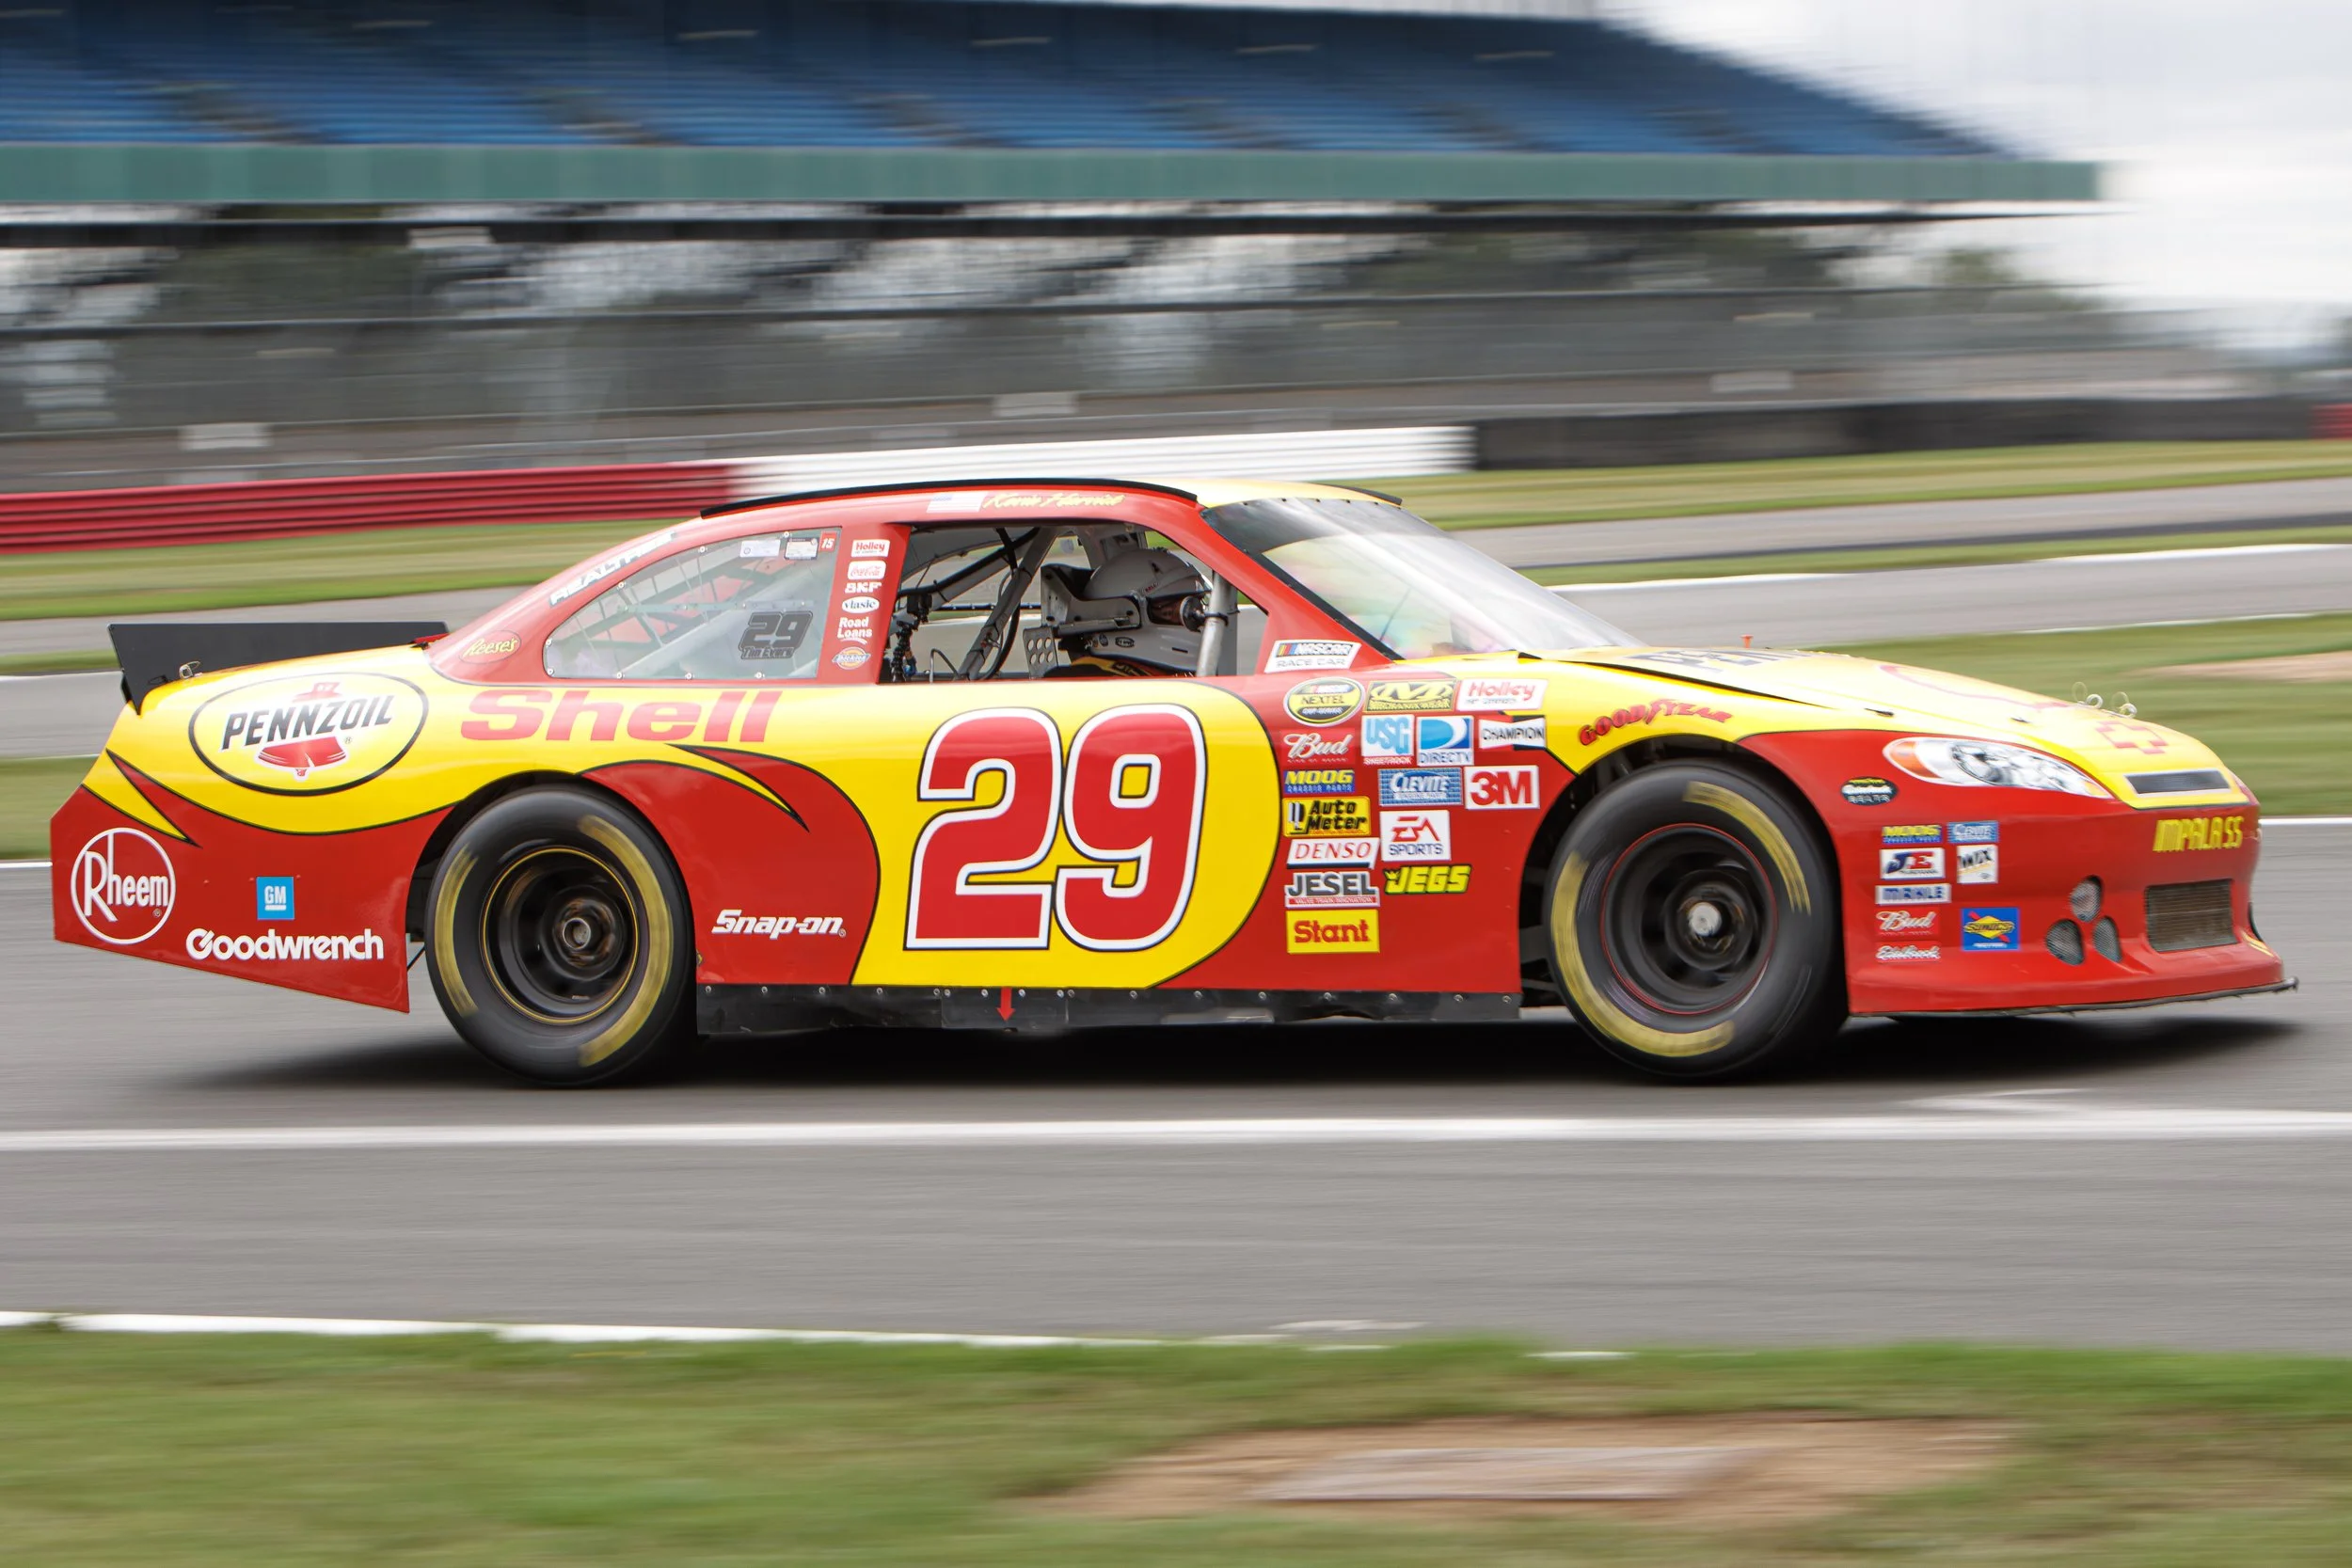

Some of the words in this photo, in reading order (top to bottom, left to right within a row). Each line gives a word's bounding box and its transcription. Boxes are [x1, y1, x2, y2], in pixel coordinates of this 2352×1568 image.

[821, 538, 834, 549] 15
[855, 542, 885, 553] Holley
[845, 582, 882, 594] SKF
[739, 611, 814, 650] 29
[837, 627, 872, 639] Loans
[839, 617, 869, 628] Road
[1295, 642, 1352, 657] NASCAR
[1277, 658, 1313, 668] RACE
[1317, 657, 1345, 667] CAR
[1301, 695, 1345, 705] NEXTEL
[1468, 681, 1535, 702] Holley
[220, 694, 394, 751] PENNZOIL
[460, 689, 783, 742] Shell
[1579, 698, 1732, 746] GOODYEAR
[1366, 717, 1410, 755] USG
[1481, 727, 1545, 741] CHAMPION
[1283, 733, 1353, 758] Bud
[1419, 752, 1471, 765] DIRECTV
[1285, 769, 1355, 785] MOOG
[1470, 770, 1533, 806] 3M
[1310, 800, 1357, 816] Auto
[903, 703, 1208, 953] 29
[1307, 816, 1368, 831] Meter
[1391, 816, 1441, 843] EA
[2152, 816, 2224, 853] IMPALA
[2222, 815, 2245, 849] SS
[1295, 841, 1372, 860] DENSO
[1388, 843, 1443, 856] SPORTS
[1958, 849, 1994, 868] WIX
[1885, 851, 1935, 874] JE
[84, 832, 168, 923] Rheem
[1287, 873, 1376, 896] JESEL
[264, 885, 287, 906] GM
[711, 909, 841, 940] Snap-on
[1294, 918, 1371, 943] Stant
[1876, 910, 1937, 931] Bud
[185, 927, 385, 961] Goodwrench
